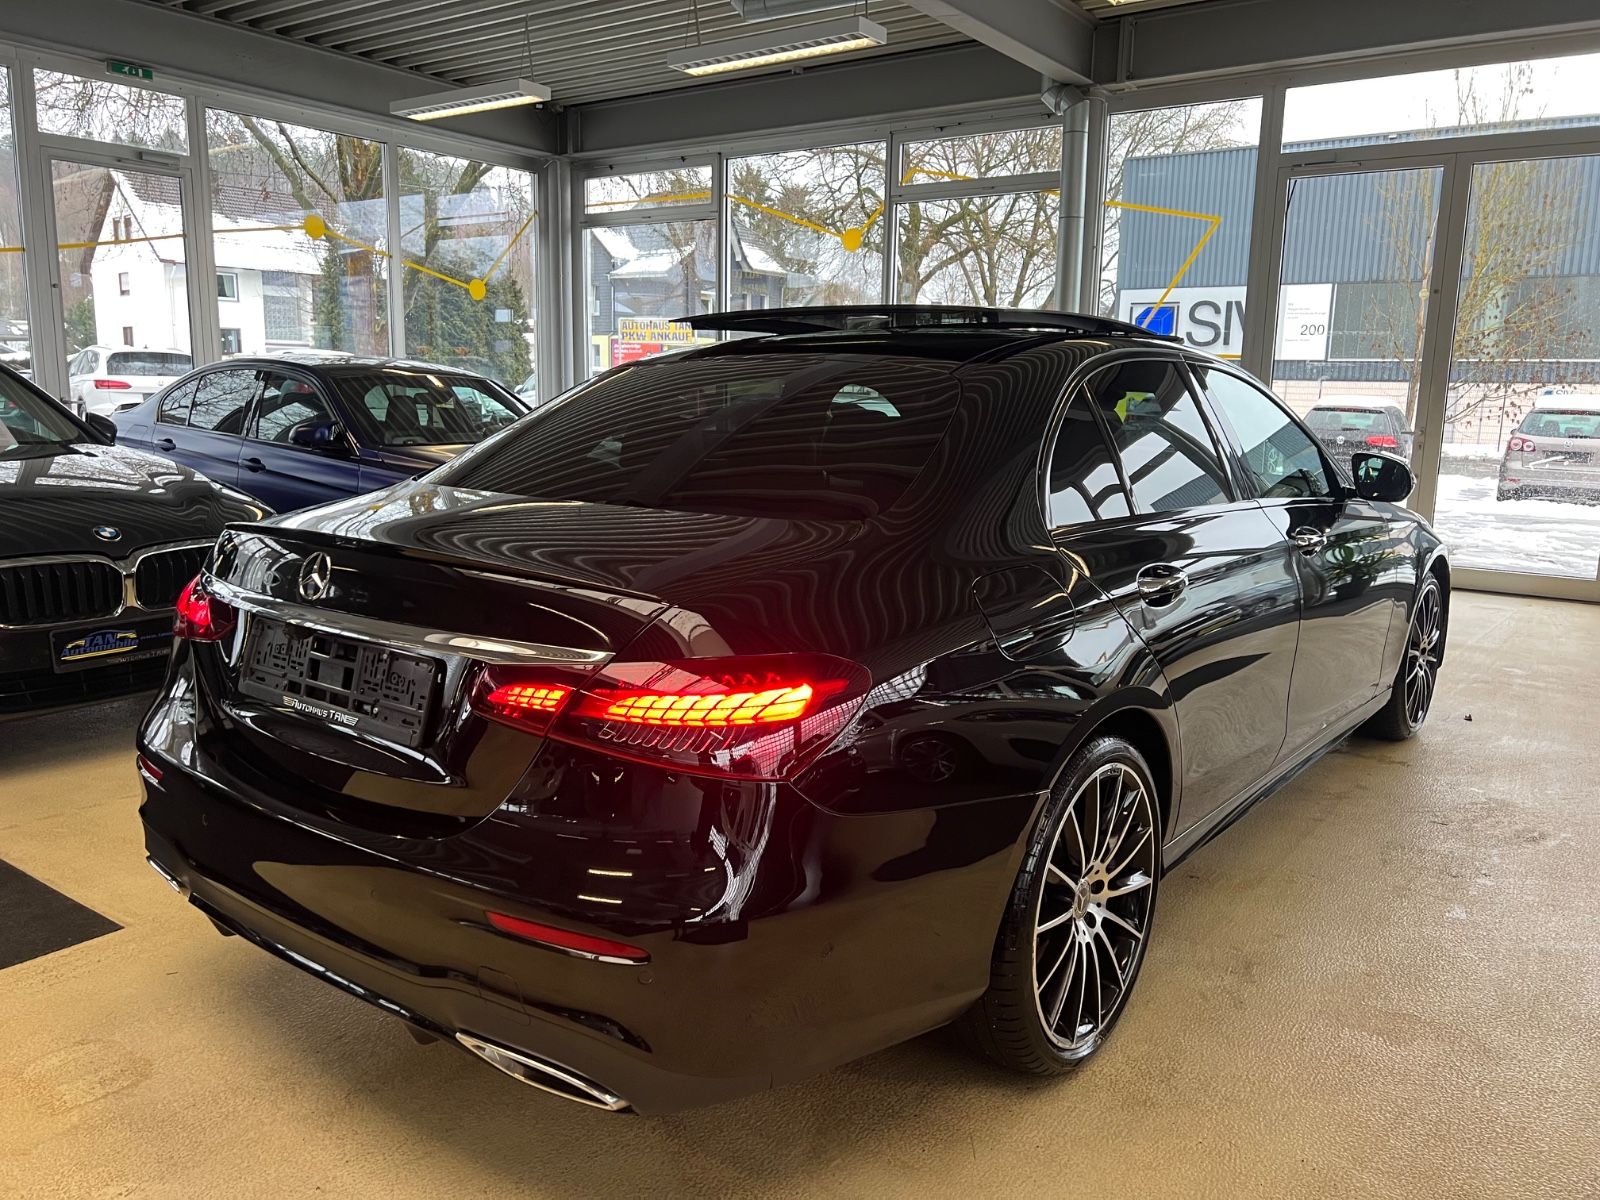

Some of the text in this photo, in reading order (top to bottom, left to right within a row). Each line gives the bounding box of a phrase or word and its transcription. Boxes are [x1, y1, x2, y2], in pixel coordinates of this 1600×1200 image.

[622, 321, 670, 330] AUTOHAUS
[1300, 324, 1325, 336] 200
[622, 332, 692, 341] PKW ANKAUF
[84, 633, 117, 647] TAN
[60, 639, 139, 657] Automobile
[329, 709, 346, 723] TAN
